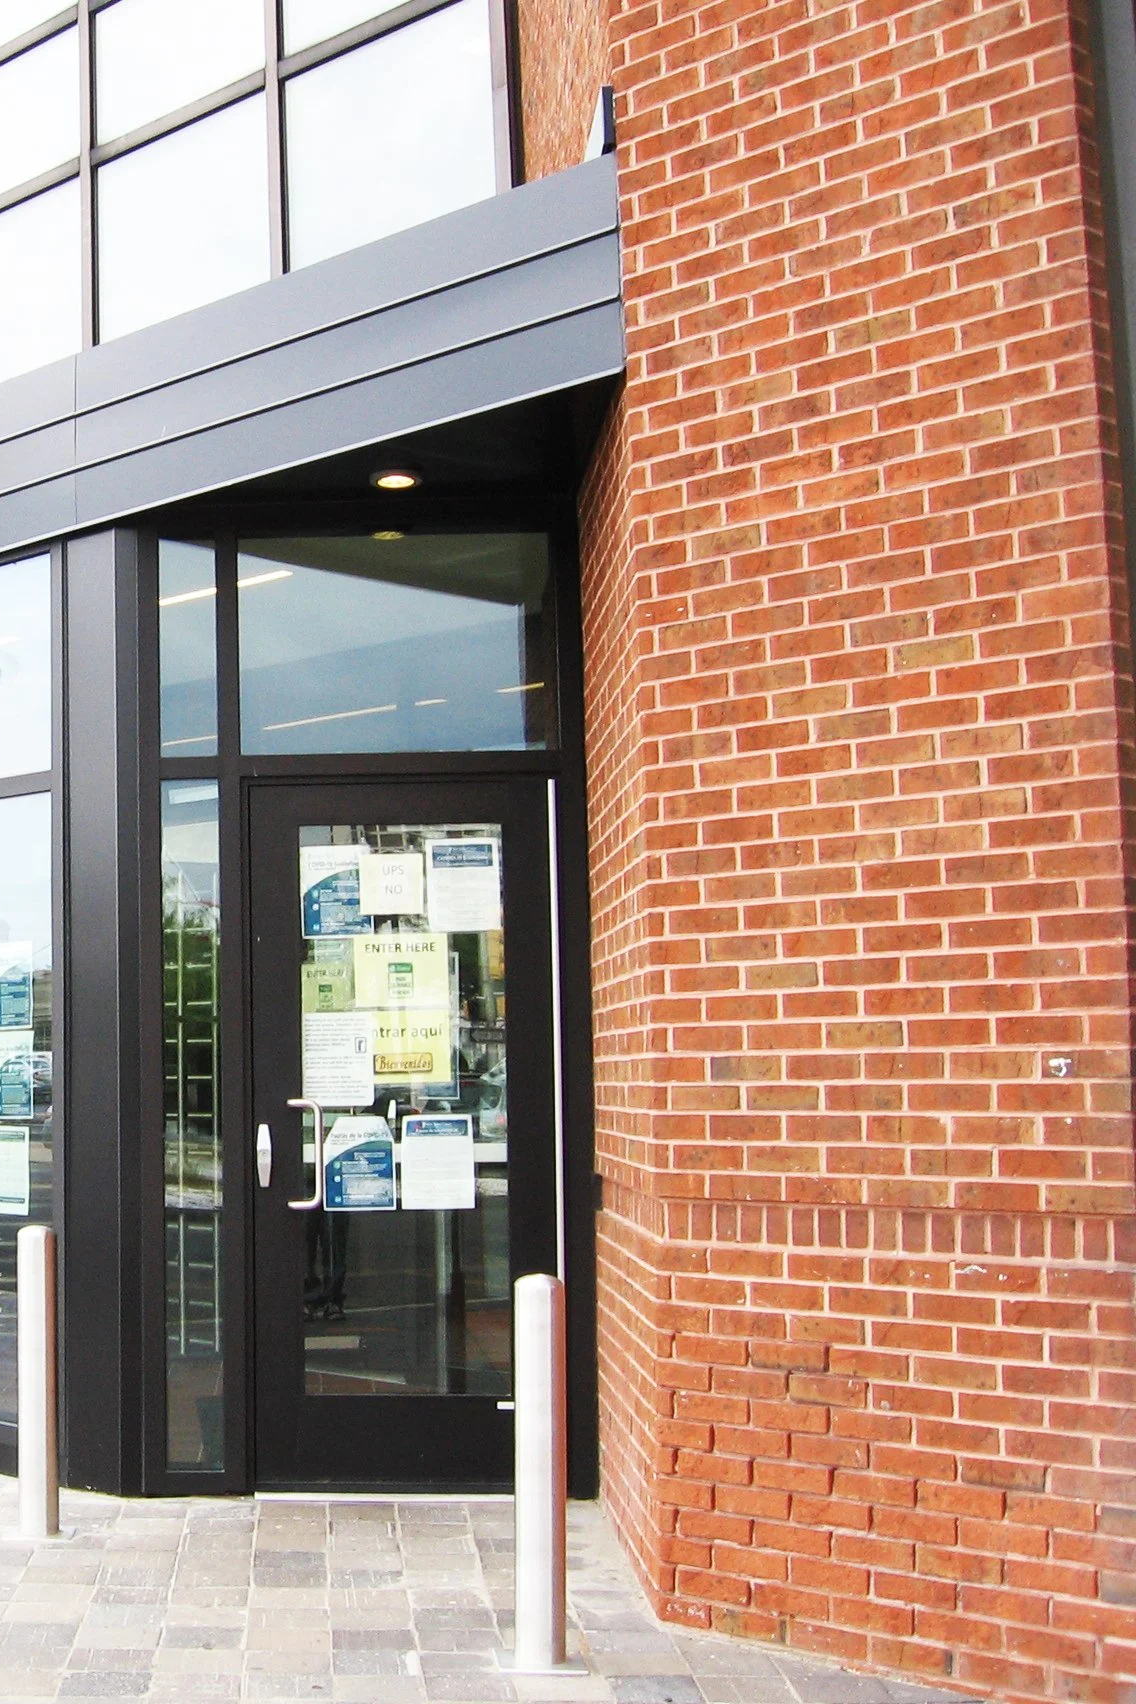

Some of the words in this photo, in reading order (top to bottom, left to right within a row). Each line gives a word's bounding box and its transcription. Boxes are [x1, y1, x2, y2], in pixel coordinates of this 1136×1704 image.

[382, 865, 405, 876] UPS
[384, 884, 404, 895] NO
[365, 943, 402, 953] ENTER
[405, 942, 436, 952] HERE
[371, 1026, 406, 1039] ntrar
[411, 1024, 443, 1039] aquí
[378, 1055, 432, 1071] Bienvenidos
